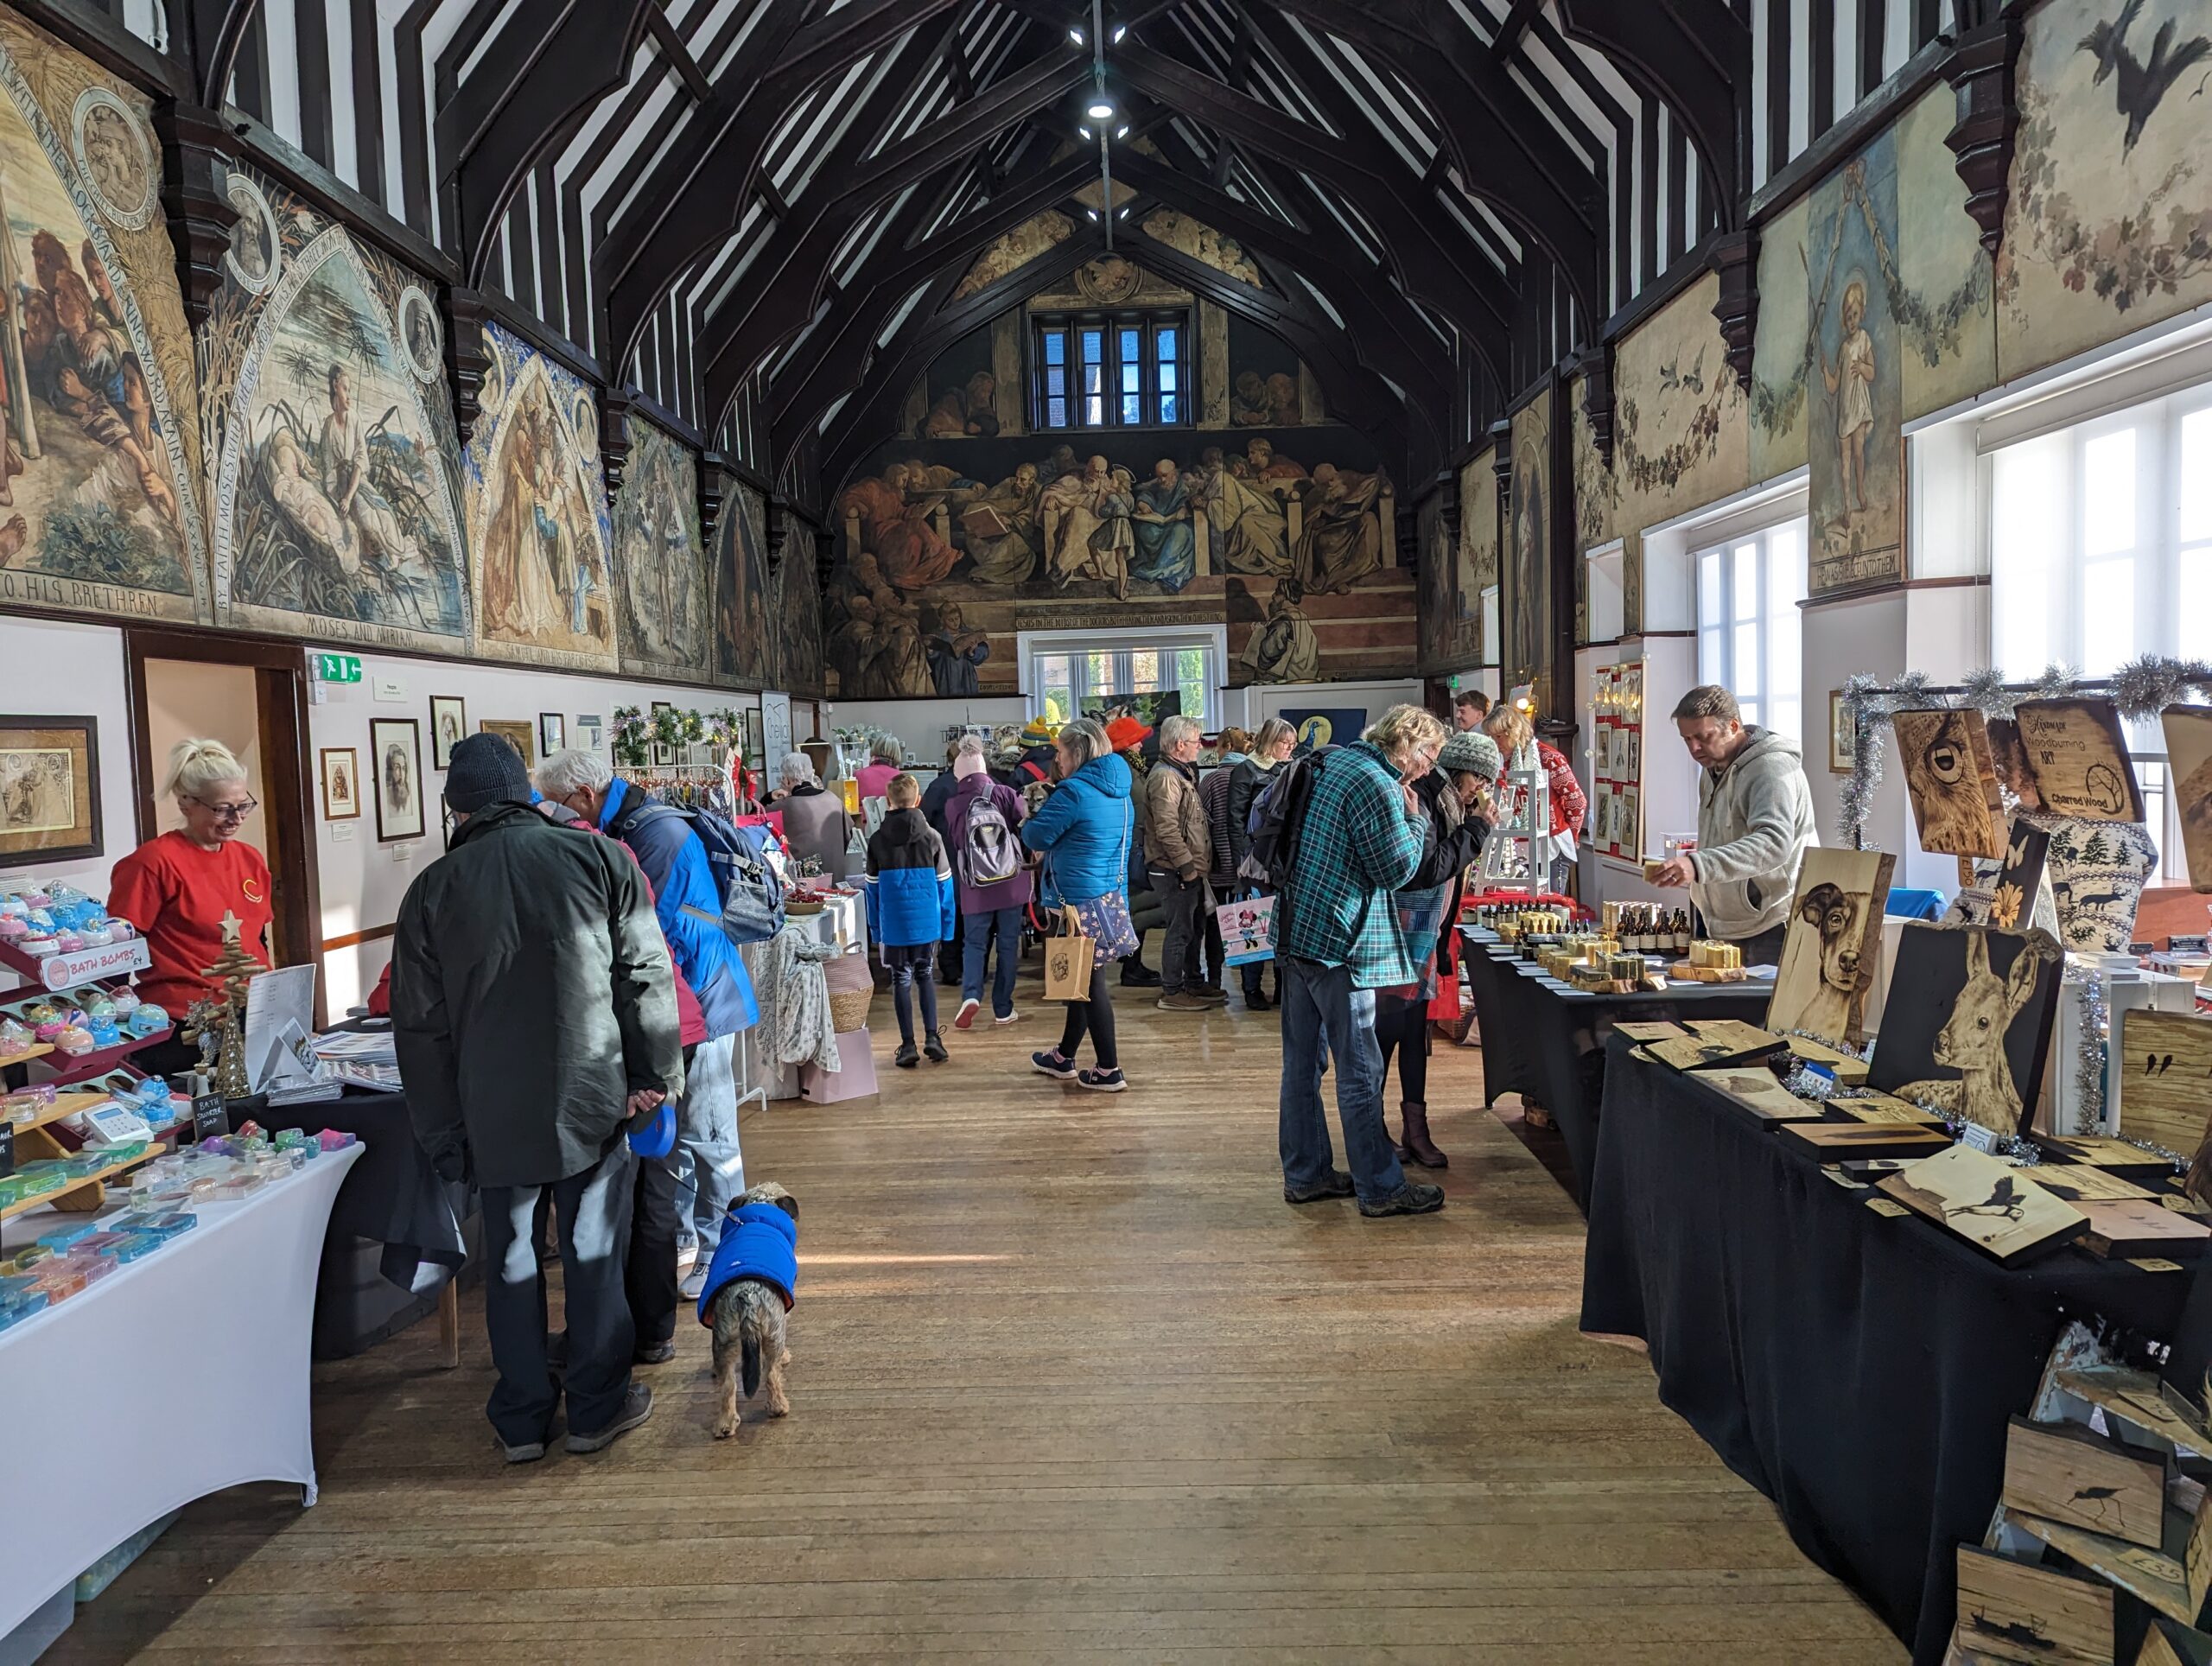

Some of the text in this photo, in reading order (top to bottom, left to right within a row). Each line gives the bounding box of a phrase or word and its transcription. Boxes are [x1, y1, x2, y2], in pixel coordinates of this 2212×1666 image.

[2025, 736, 2086, 752] Woodburning
[2040, 751, 2056, 766] ART
[2051, 793, 2109, 809] Charred Wood
[70, 957, 98, 976] BATH
[100, 949, 136, 968] BOMBS
[133, 957, 143, 966] £4
[199, 1097, 219, 1111] BATH
[202, 1117, 218, 1128] SOAP
